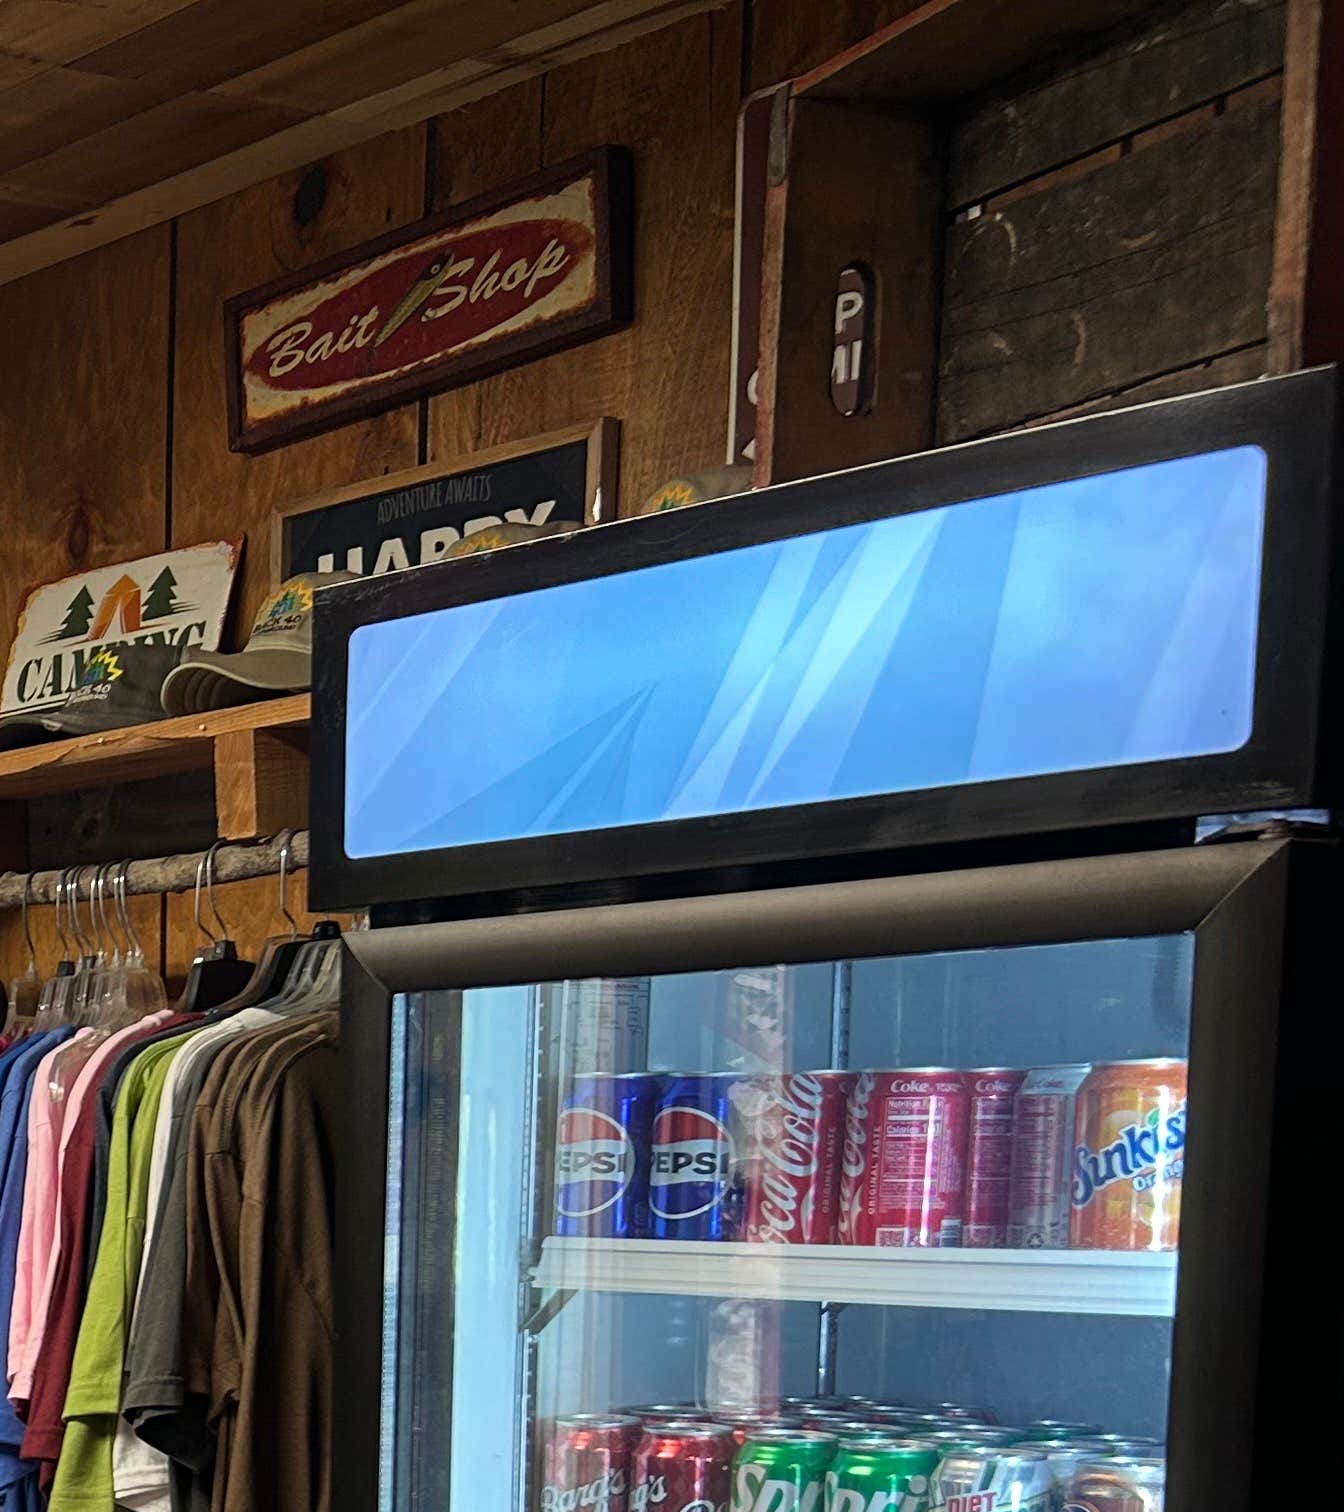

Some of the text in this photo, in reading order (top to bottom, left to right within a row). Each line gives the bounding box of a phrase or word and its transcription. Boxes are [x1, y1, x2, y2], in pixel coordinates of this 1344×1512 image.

[267, 237, 571, 378] Bait Shop
[376, 473, 495, 525] ADVENTURE AWAITS
[891, 1079, 929, 1094] Coke
[976, 1079, 1010, 1093] Coke
[649, 1151, 730, 1175] PEPSI
[867, 1127, 881, 1216] ORIGINAL TASTE
